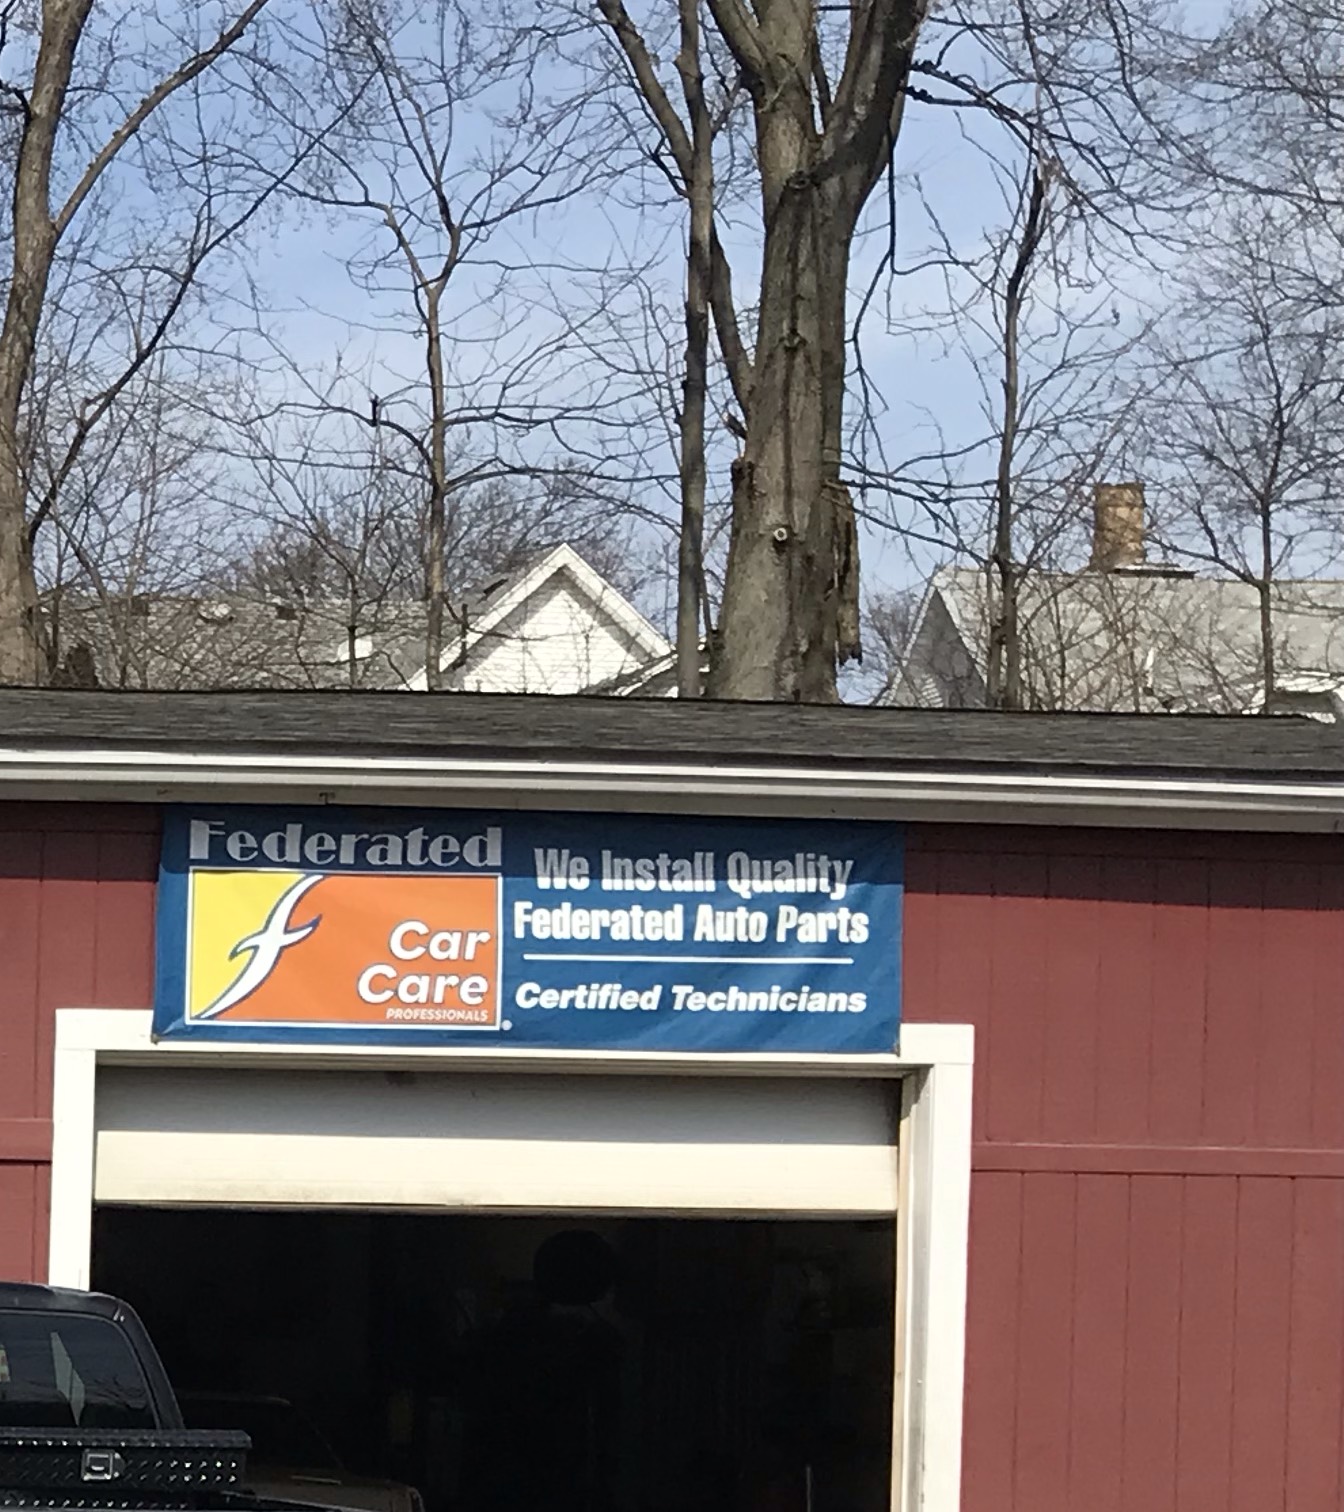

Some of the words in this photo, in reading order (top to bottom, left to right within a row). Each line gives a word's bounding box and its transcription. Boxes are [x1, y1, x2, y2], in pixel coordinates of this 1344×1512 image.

[189, 819, 502, 867] Federated
[534, 848, 590, 890] We
[601, 850, 715, 892] Install
[727, 851, 854, 900] Quality
[388, 920, 491, 961] Car
[514, 901, 684, 941] Federated
[693, 904, 768, 941] Auto
[776, 905, 869, 943] Parts
[357, 964, 489, 1004] Care
[515, 982, 662, 1011] Certified
[671, 985, 867, 1013] Technicians
[386, 1007, 488, 1022] PROFESSIONALS
